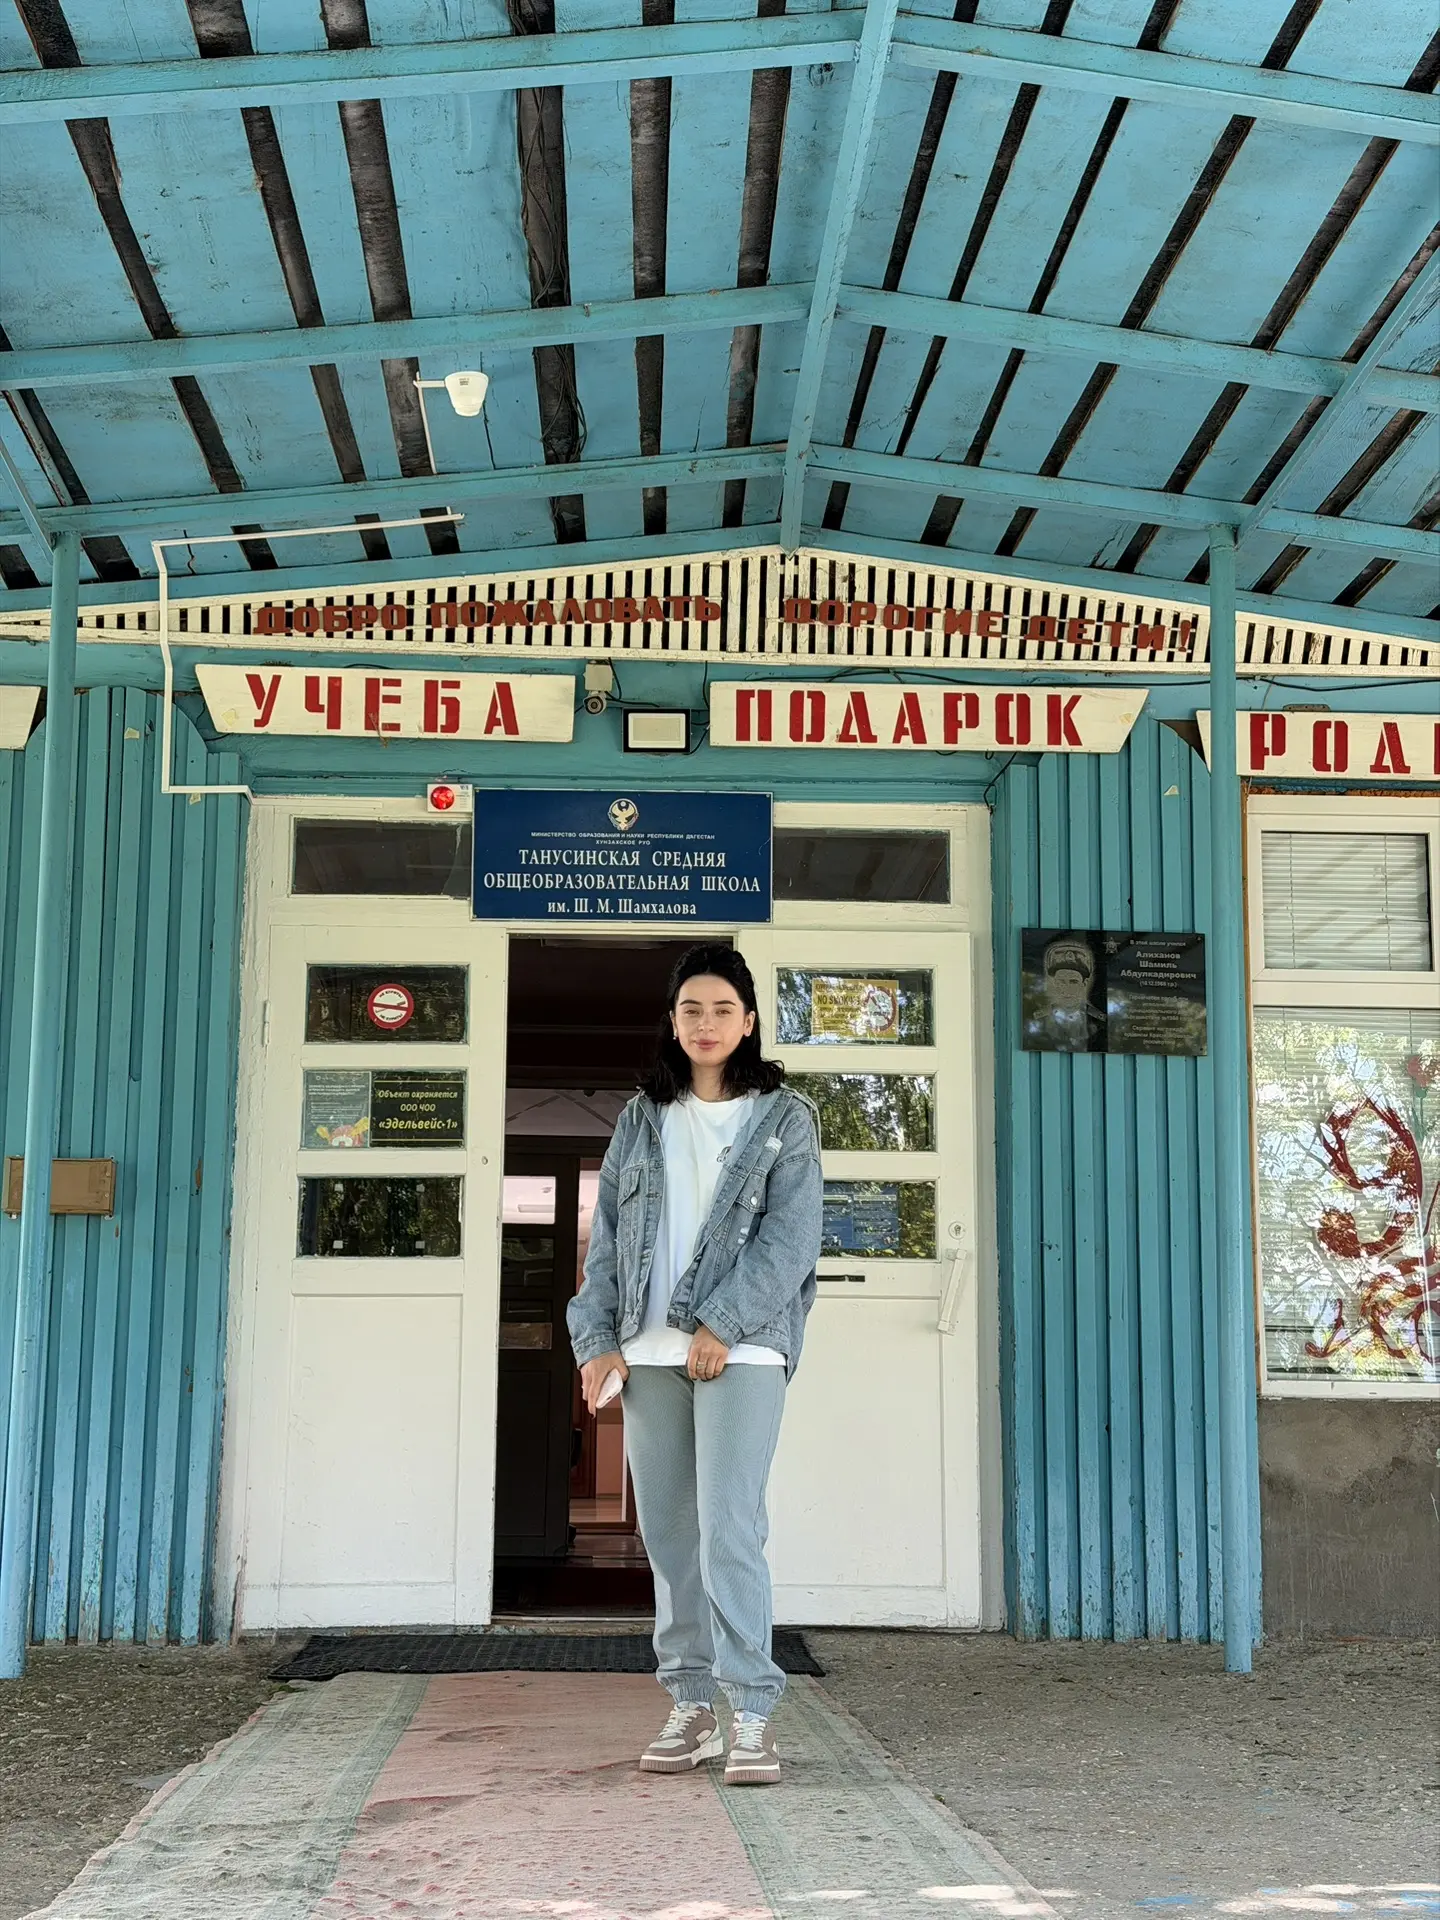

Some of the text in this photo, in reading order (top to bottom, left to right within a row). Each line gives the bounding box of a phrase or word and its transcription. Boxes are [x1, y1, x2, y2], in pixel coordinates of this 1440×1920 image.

[253, 595, 1192, 653] ДОБРО ПОЖАЛОВАТЬ ДОРОГИЕ ДЕТИ!
[245, 673, 519, 736] УЧЕБА
[735, 688, 1083, 747] ПОДАРОК
[1249, 713, 1440, 775] РОД
[518, 849, 727, 870] ТАНУСИНСКАЯ СРЕДНЯЯ
[483, 872, 761, 892] ОБЩЕОБРАЗОВАТЕЛЬНАЯ ШКОЛА
[547, 898, 697, 915] им. Ш. М. Шамхалова
[1136, 951, 1180, 960] Алиханов
[1139, 960, 1177, 969] Шамиль
[1120, 969, 1197, 980] Абдулкадирович
[378, 1089, 458, 1100] Объект охраняется
